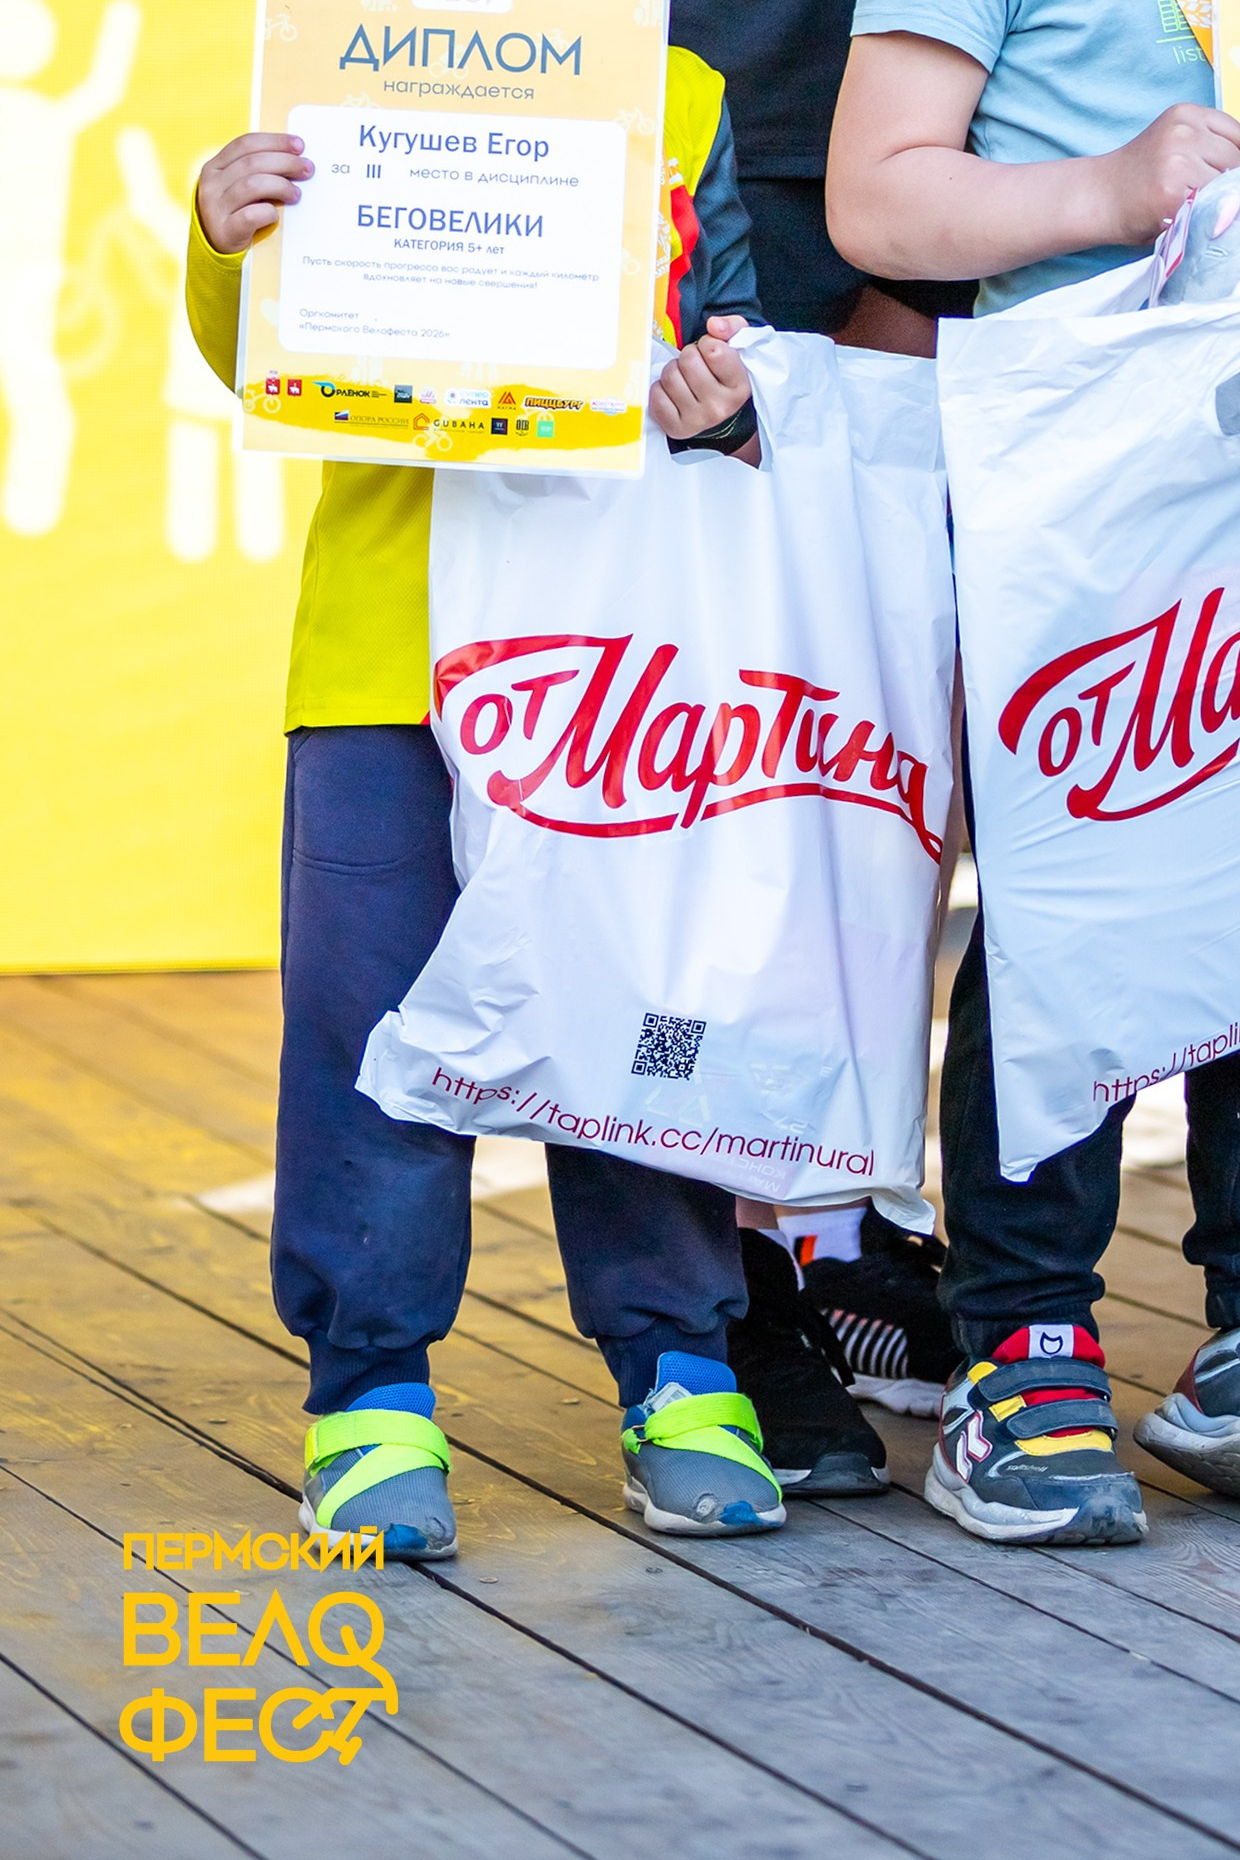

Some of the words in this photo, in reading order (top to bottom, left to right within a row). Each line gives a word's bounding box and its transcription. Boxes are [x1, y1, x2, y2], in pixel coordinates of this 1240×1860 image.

[339, 23, 582, 76] ДИПЛОМ
[383, 79, 535, 100] награждается
[359, 124, 478, 154] Кугушев
[487, 132, 550, 161] Егор
[331, 163, 351, 174] за
[409, 168, 460, 181] место
[464, 171, 473, 181] в
[477, 171, 579, 188] дисциплине
[357, 205, 544, 238] БЕГОВЕЛИКИ
[393, 238, 465, 253] КАТЕГОРИЯ
[467, 243, 483, 254] 5+
[486, 245, 505, 255] лет
[302, 255, 333, 267] Пусть
[334, 259, 382, 269] скорость
[384, 262, 439, 272] прогресса
[441, 265, 459, 273] вас
[462, 267, 498, 276] радует
[509, 270, 550, 279] каждый
[551, 272, 600, 282] километр
[363, 273, 427, 283] вдохновляет
[445, 278, 476, 286] новые
[299, 308, 359, 319] Оргкомитет
[362, 325, 418, 337] Велофеста
[459, 669, 580, 756] от
[1038, 662, 1135, 777] от
[487, 633, 943, 865] Мартина
[431, 1067, 877, 1177] https://taplink.cc/martinural
